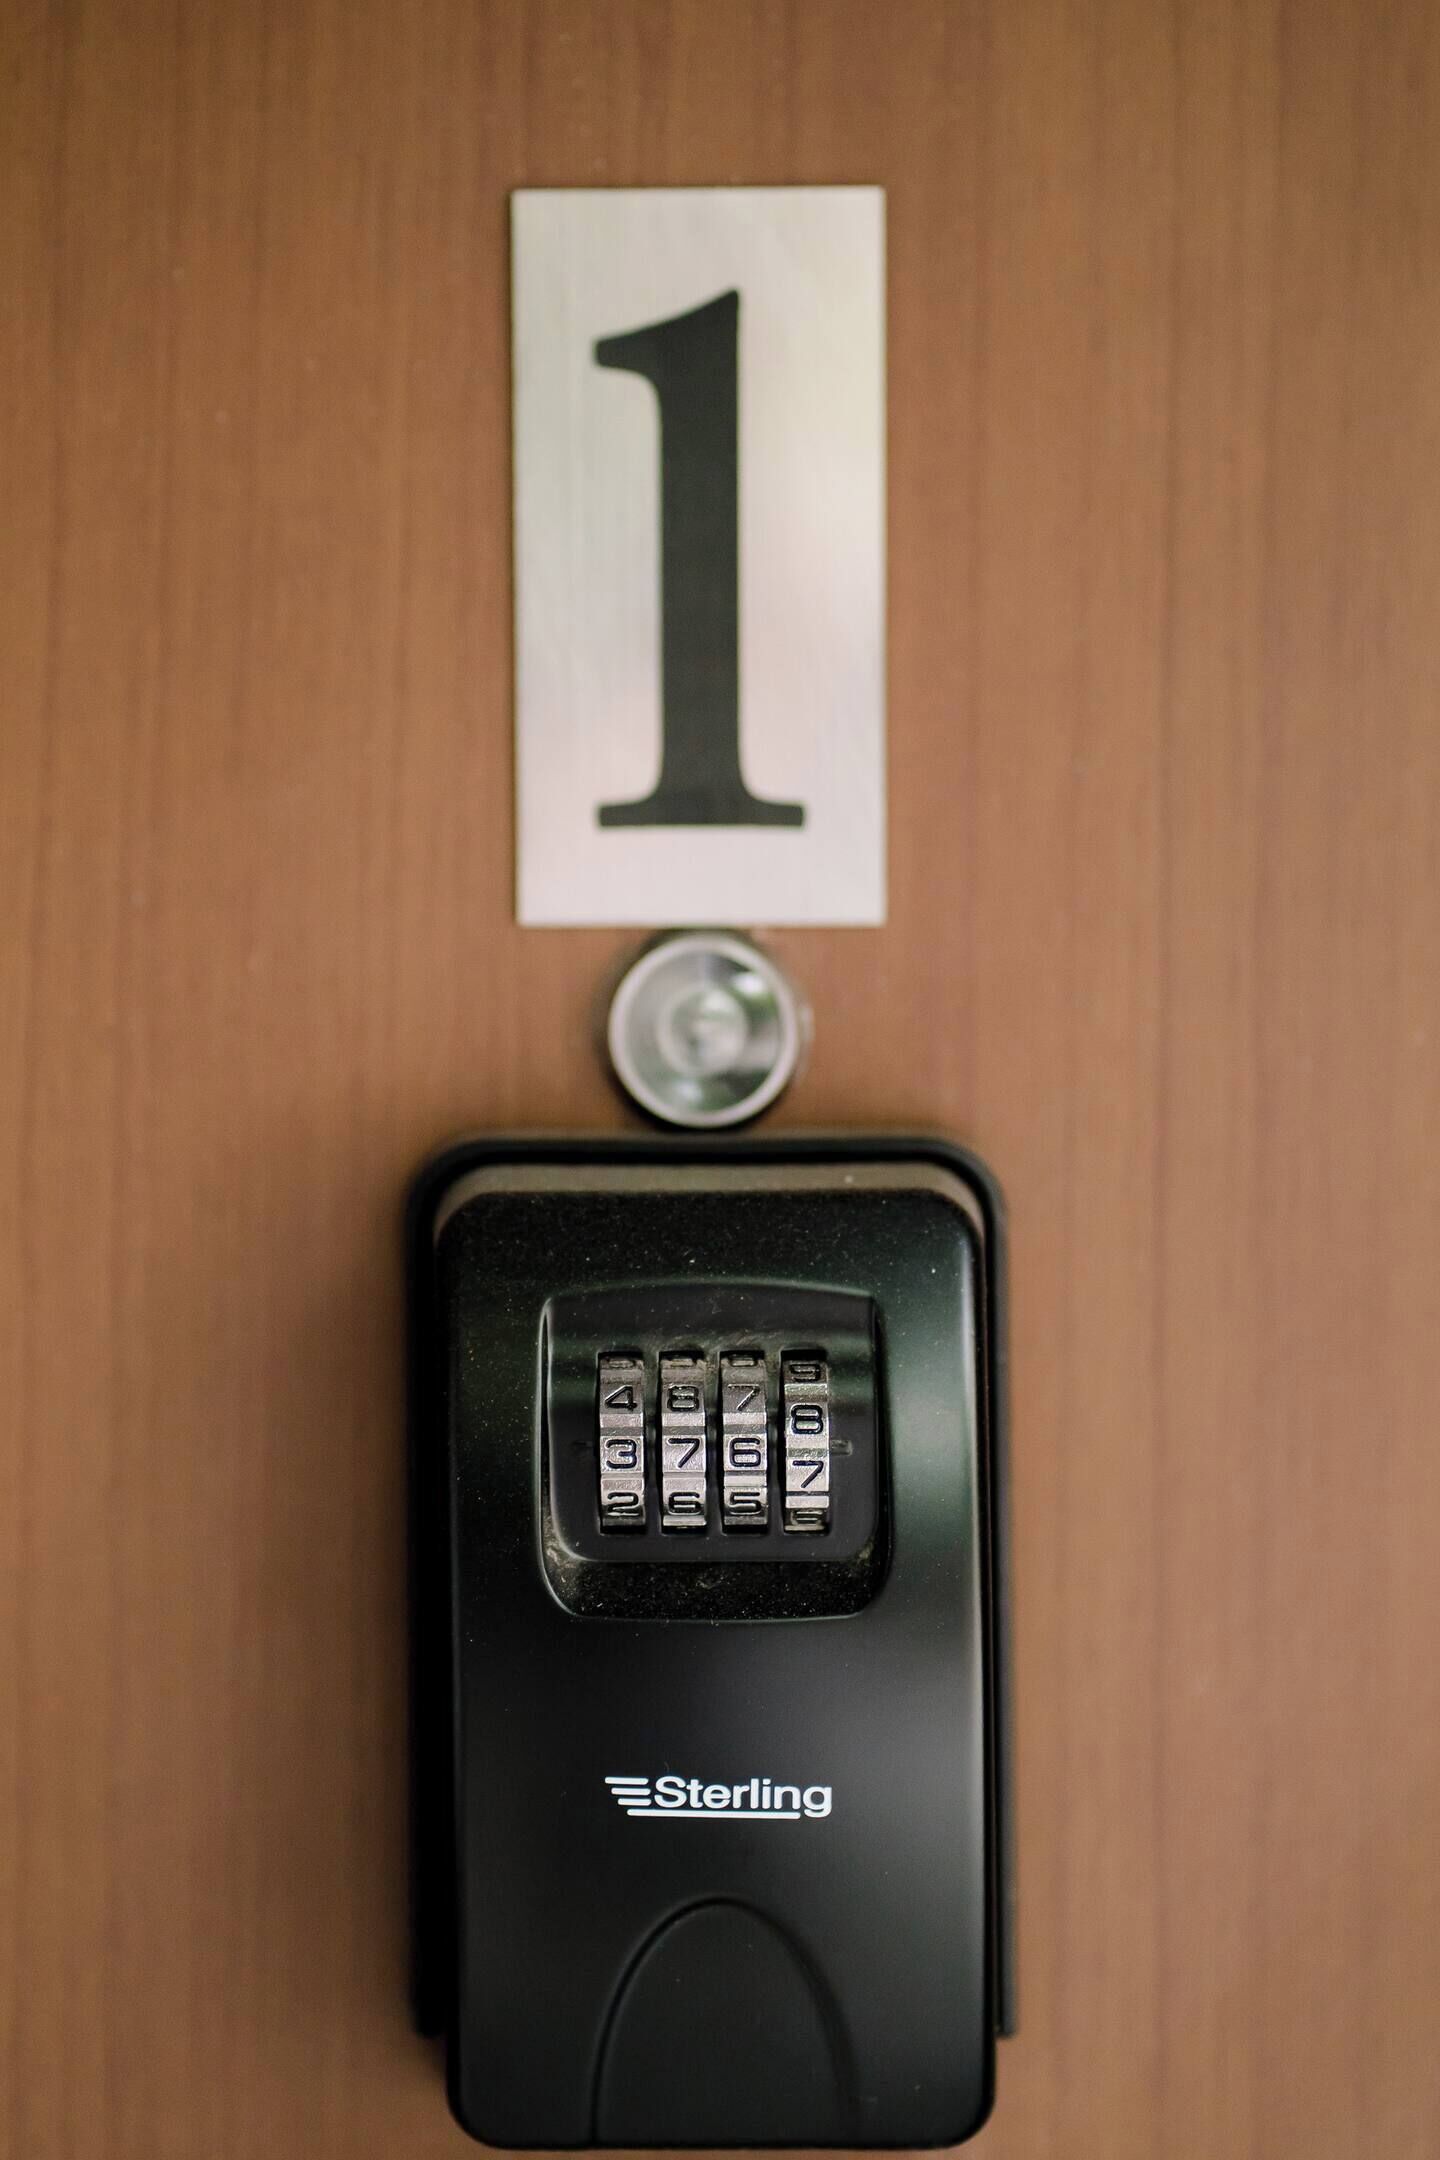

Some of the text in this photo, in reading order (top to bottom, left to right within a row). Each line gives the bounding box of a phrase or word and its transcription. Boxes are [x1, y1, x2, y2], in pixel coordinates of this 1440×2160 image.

[594, 288, 805, 828] 1
[604, 1384, 824, 1434] 4 8 7 8
[605, 1437, 824, 1488] 3 7 6 7
[606, 1492, 761, 1517] 2 6 5
[654, 1776, 832, 1818] Sterling
